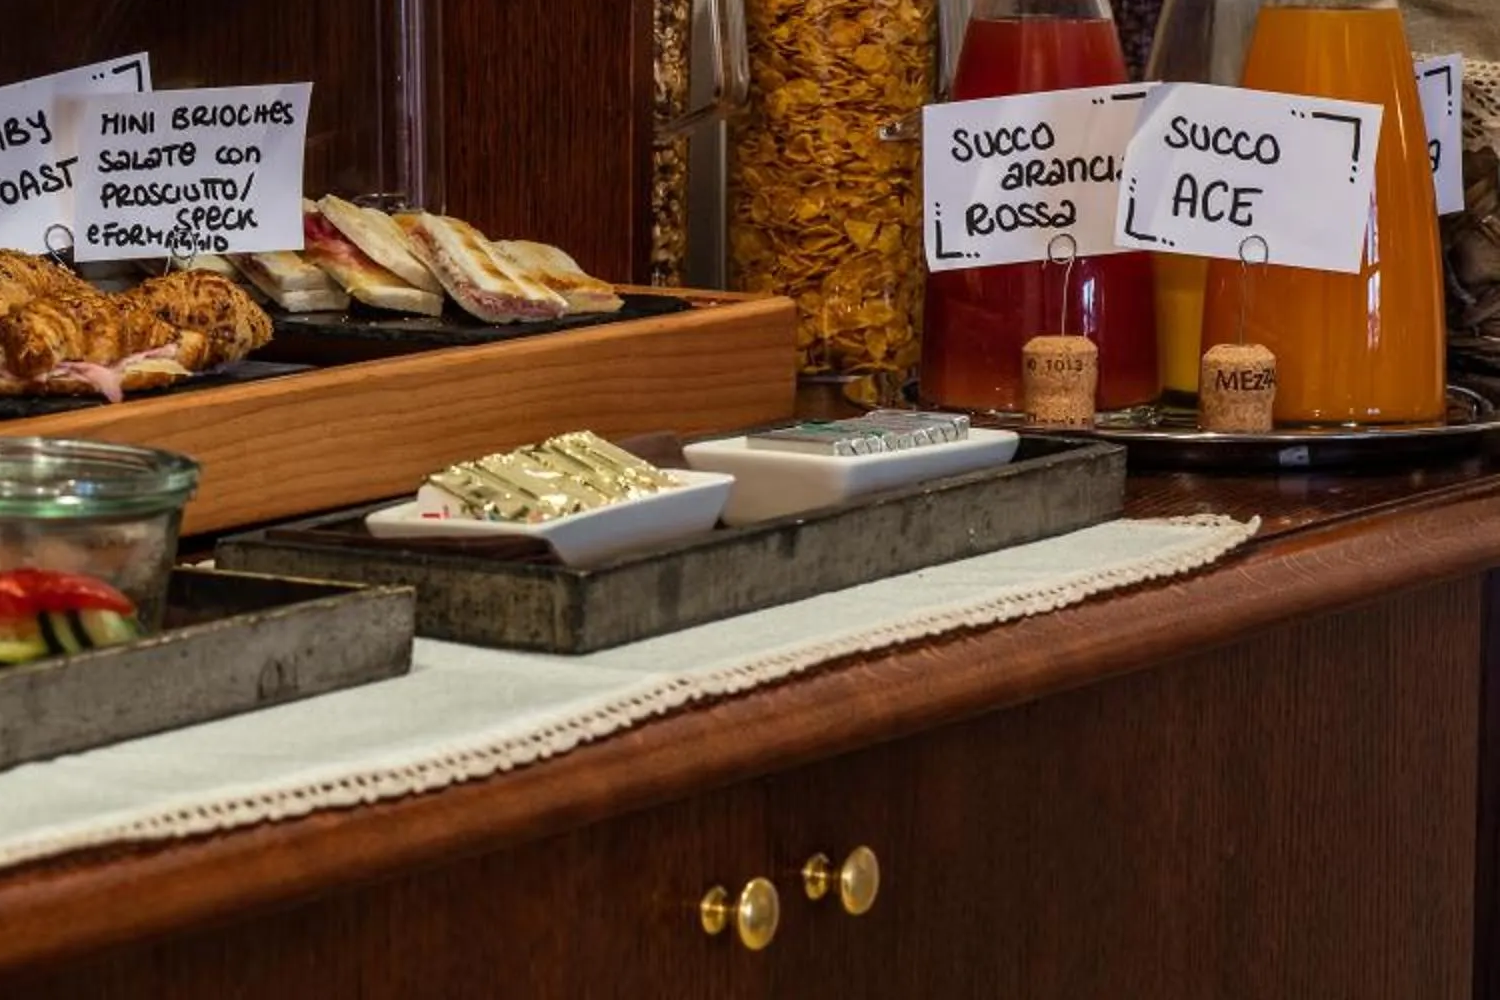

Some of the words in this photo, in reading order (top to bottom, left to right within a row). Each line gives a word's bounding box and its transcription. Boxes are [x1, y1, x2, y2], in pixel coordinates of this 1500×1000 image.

[100, 111, 155, 136] MINI
[951, 121, 1055, 163] SUCCO
[1164, 115, 1281, 165] SUCCO
[215, 145, 261, 166] con
[1172, 172, 1264, 227] ACE
